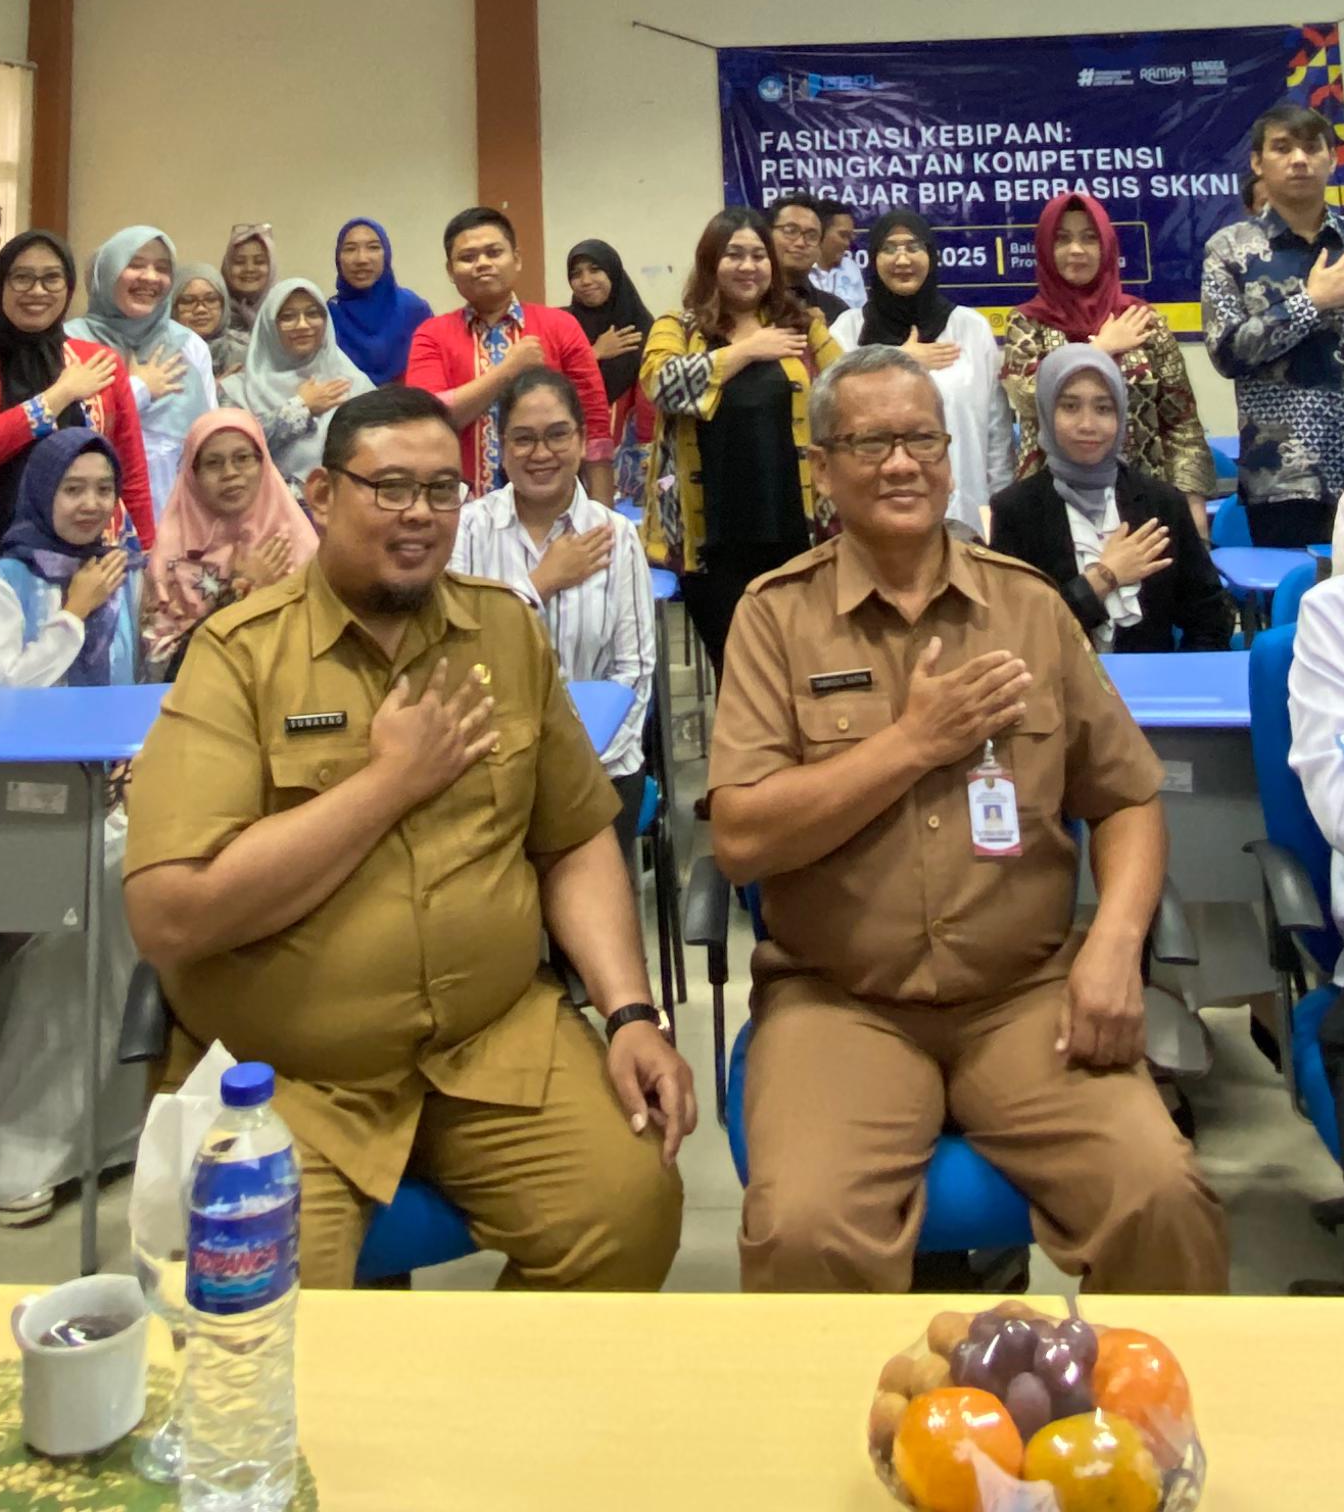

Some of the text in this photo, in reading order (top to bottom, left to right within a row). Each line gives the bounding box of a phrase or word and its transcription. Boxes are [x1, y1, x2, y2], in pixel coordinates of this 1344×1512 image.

[1139, 67, 1186, 81] RAMAH
[759, 121, 1072, 153] FASILITASI KEBIPAAN:
[761, 146, 1164, 181] PENINGKATAN KOMPETENSI
[918, 180, 985, 204] BIPA
[1150, 172, 1239, 198] SKKNI
[936, 246, 986, 267] 025
